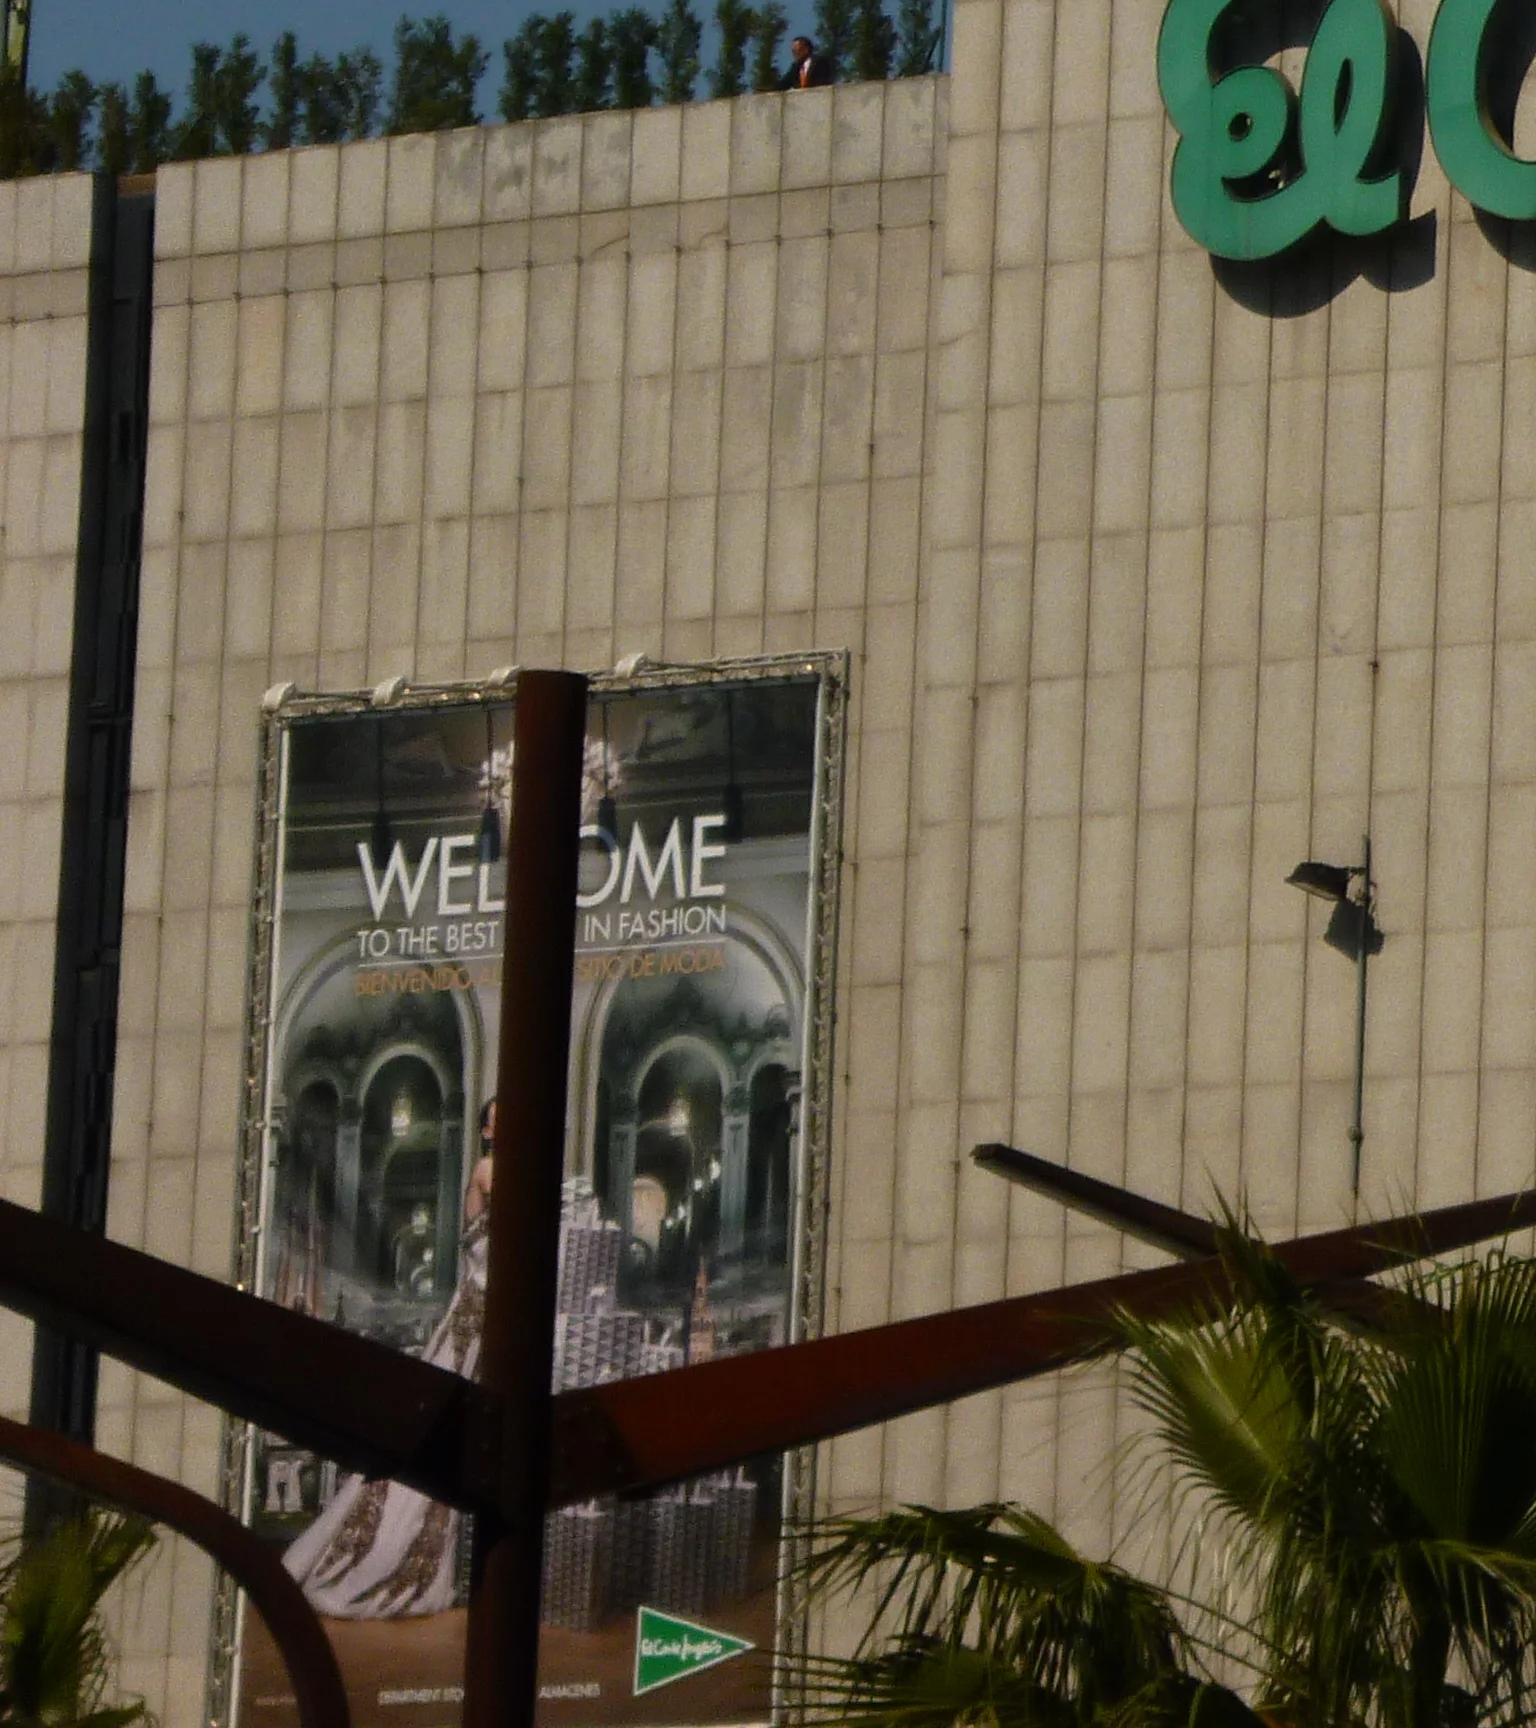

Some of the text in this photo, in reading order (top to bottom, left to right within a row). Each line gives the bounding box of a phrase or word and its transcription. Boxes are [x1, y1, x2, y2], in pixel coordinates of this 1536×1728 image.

[357, 813, 727, 922] WELOME
[357, 903, 727, 958] TO THE BEST IN FASHION
[355, 966, 474, 996] BIENVENIDO
[629, 952, 655, 978] DE
[660, 945, 726, 975] MODA
